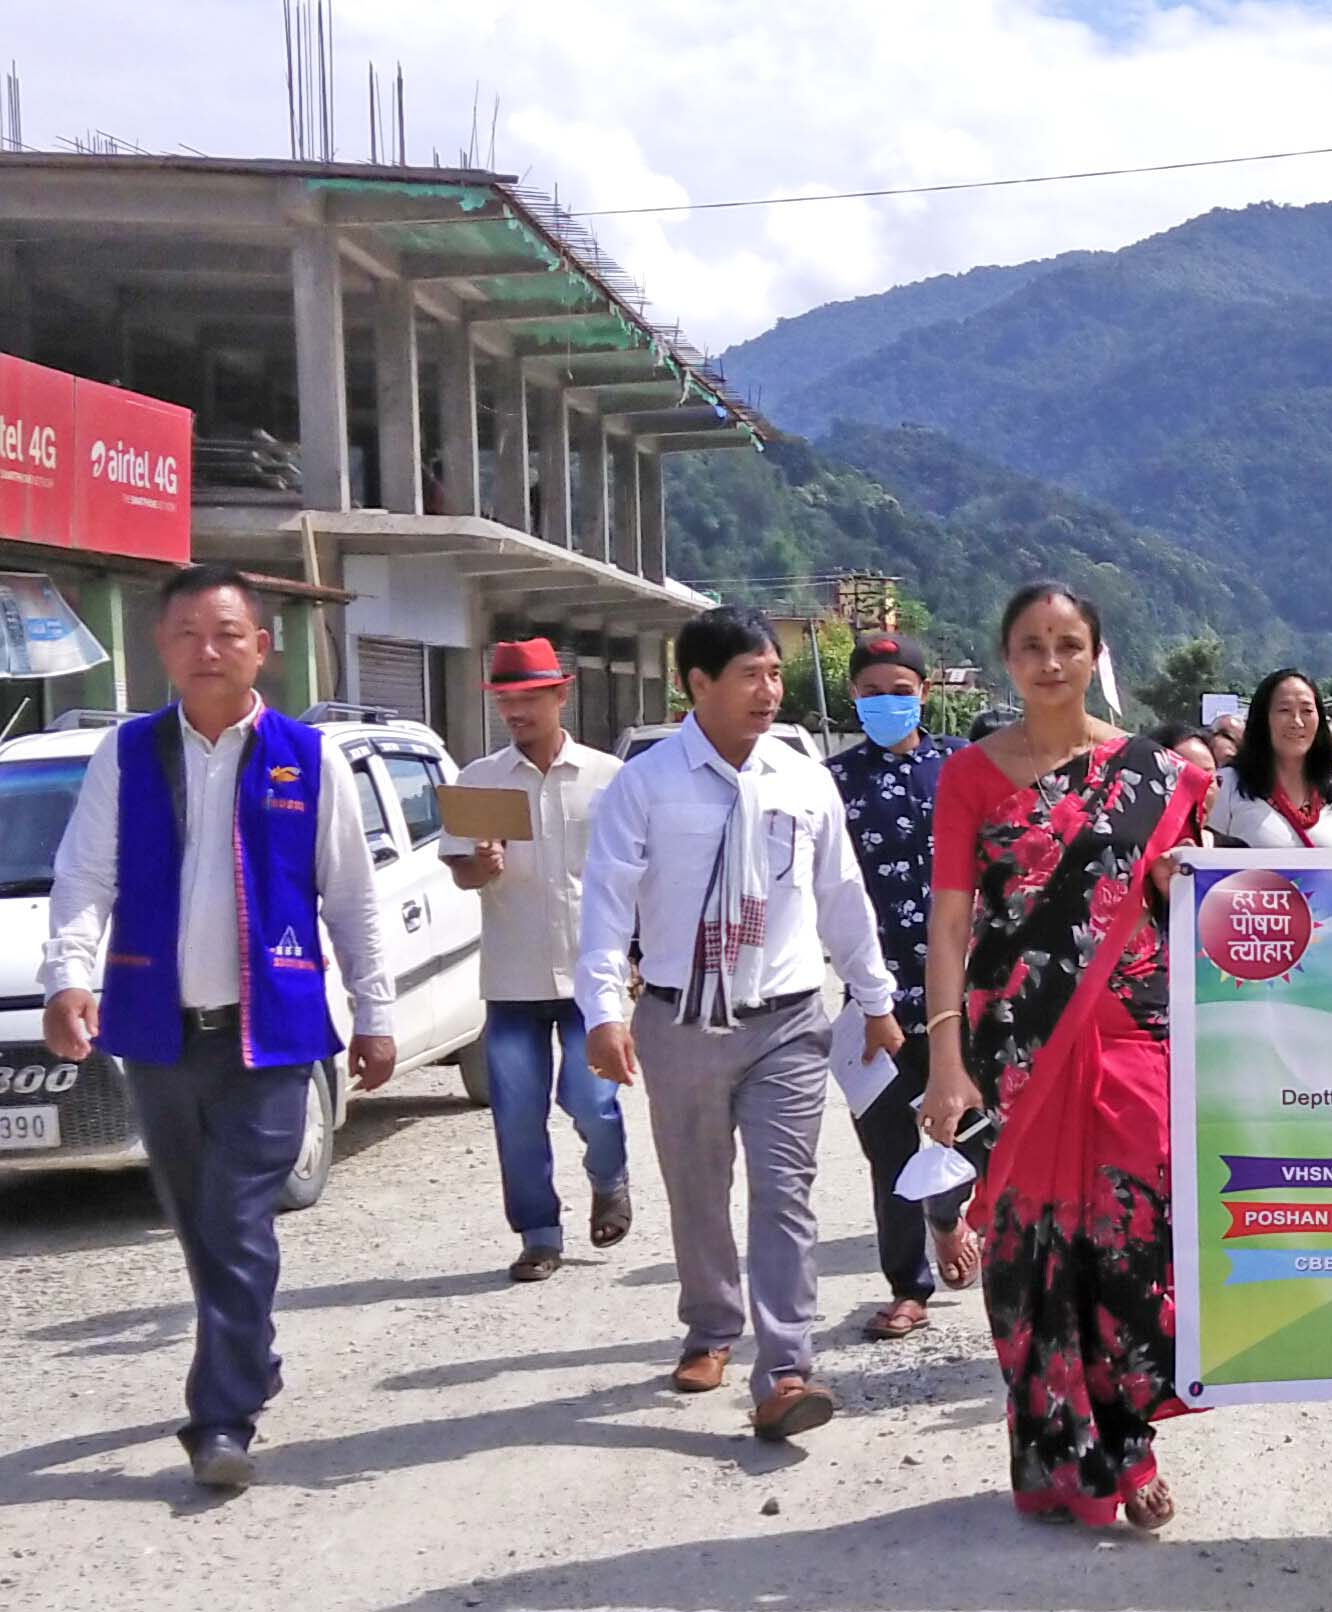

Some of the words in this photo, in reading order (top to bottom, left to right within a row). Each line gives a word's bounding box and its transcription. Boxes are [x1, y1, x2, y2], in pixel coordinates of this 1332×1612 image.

[28, 425, 56, 469] 4G
[107, 440, 151, 489] airtel
[154, 456, 178, 495] 4G
[1230, 890, 1257, 910] हर
[1260, 890, 1291, 910] घर
[1229, 908, 1292, 935] पोषण
[1227, 934, 1295, 963] त्योहार
[1245, 1210, 1329, 1226] POSHAN
